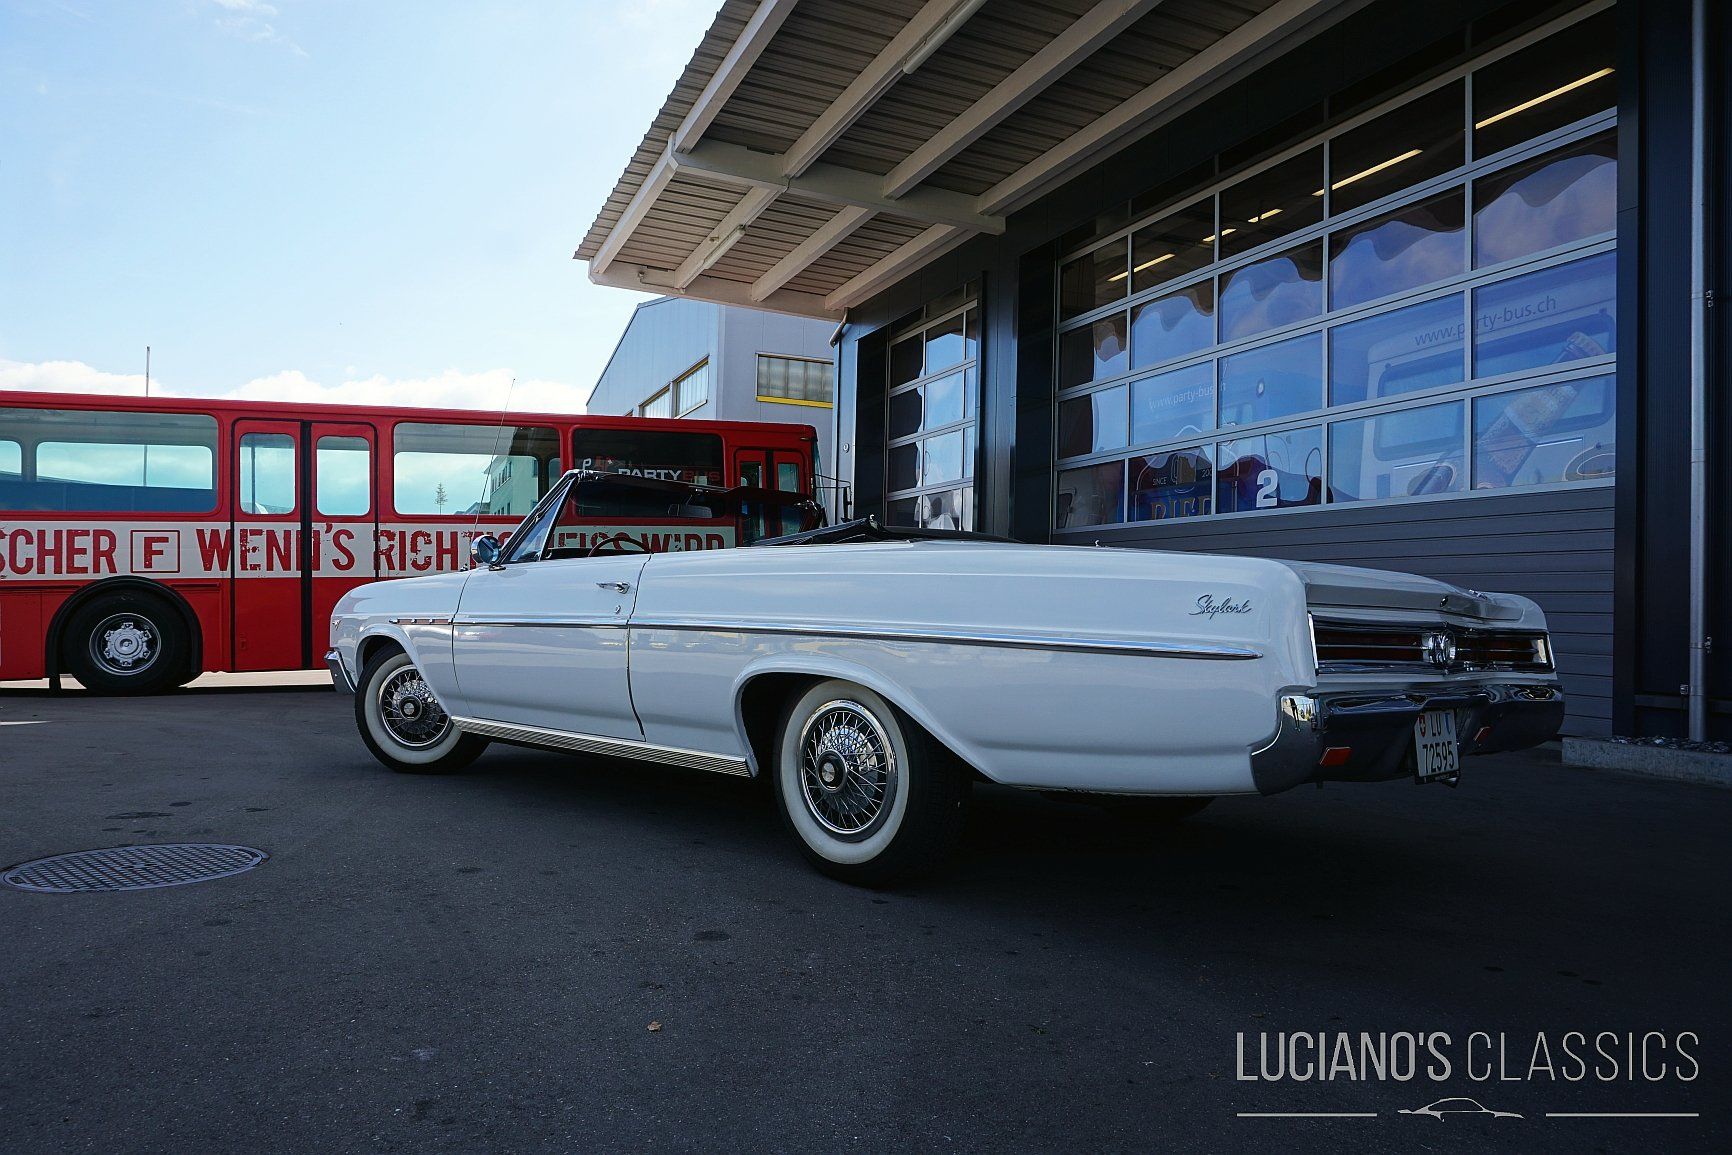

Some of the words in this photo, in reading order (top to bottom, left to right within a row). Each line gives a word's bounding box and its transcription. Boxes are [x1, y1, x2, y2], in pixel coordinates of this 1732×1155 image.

[1414, 296, 1557, 346] www.prty-bus.ch
[1149, 382, 1226, 409] www.party-bush
[1256, 469, 1278, 507] 2
[0, 529, 117, 574] CHER
[144, 537, 169, 568] F
[1188, 594, 1252, 620] Skylark
[1422, 741, 1455, 774] 72595
